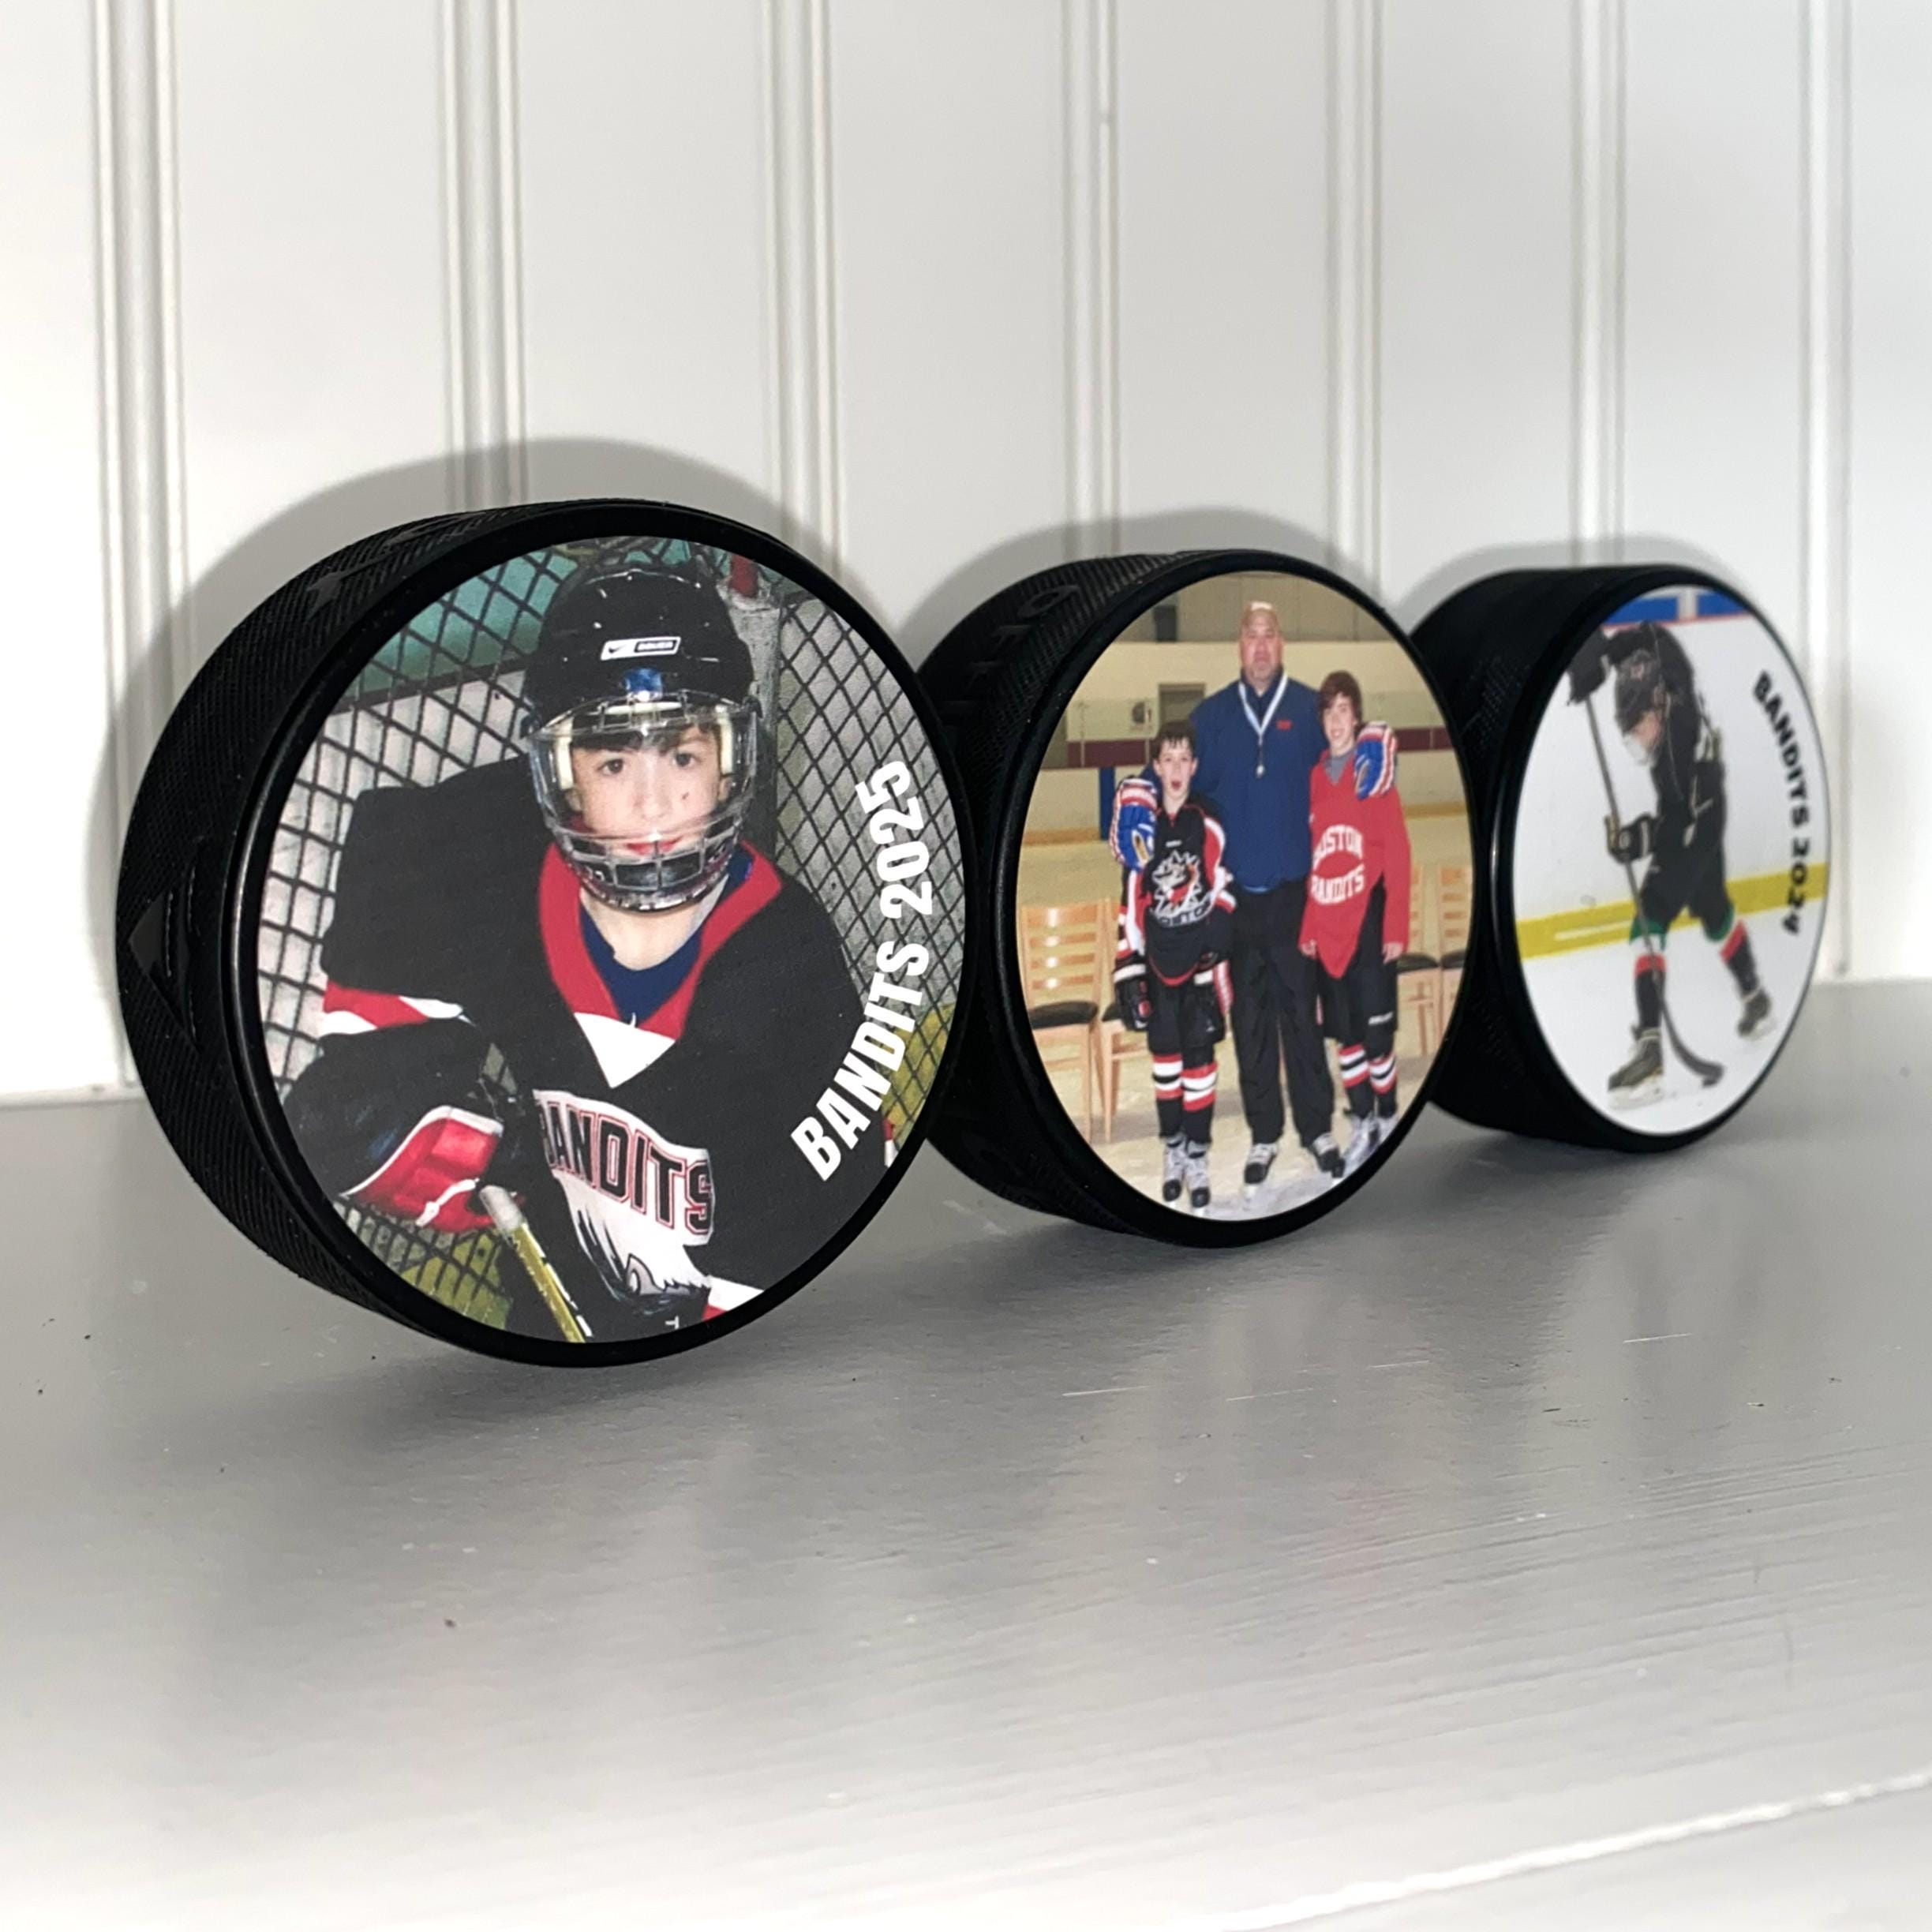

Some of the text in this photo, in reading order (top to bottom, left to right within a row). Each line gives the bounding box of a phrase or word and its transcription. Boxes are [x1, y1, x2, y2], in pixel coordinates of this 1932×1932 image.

[1753, 670, 1810, 935] BANDITS 2024
[791, 760, 933, 1181] BANDITS 2025
[537, 1099, 713, 1236] ANDITS
